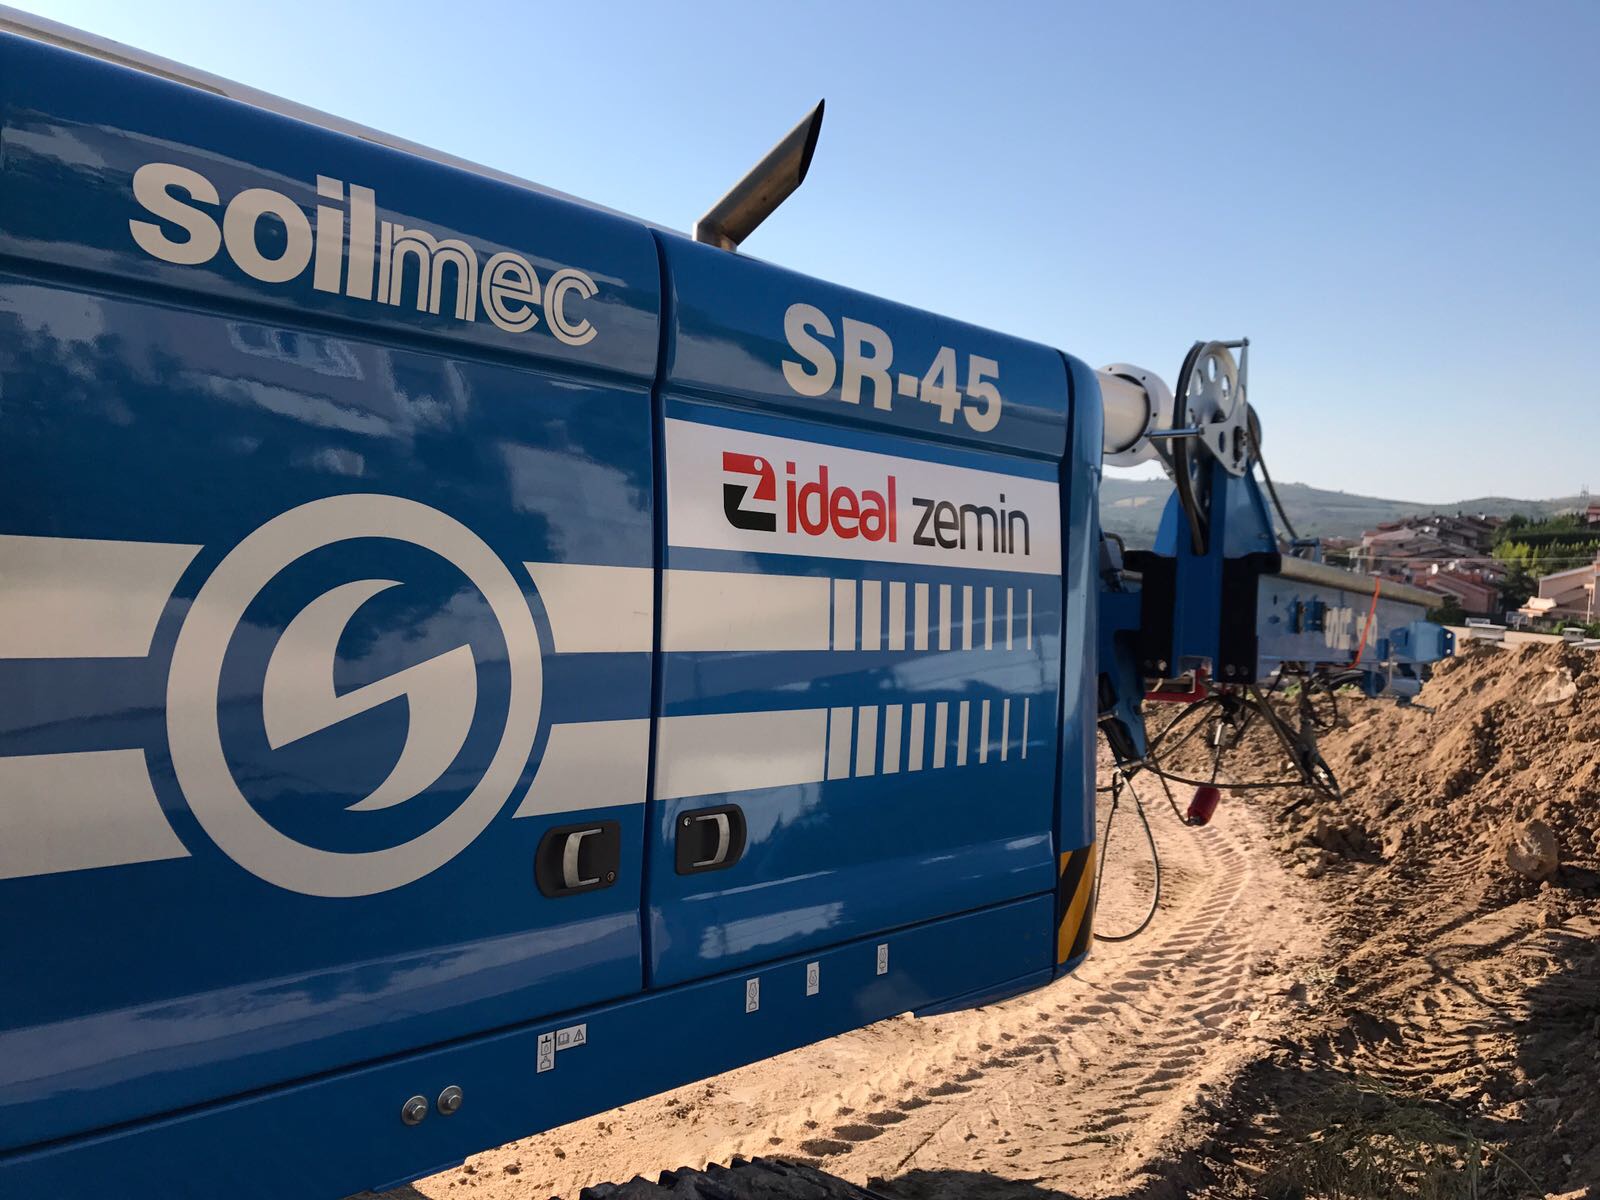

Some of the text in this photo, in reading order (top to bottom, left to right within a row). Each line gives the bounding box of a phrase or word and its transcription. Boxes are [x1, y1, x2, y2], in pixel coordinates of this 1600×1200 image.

[128, 162, 601, 347] soilmec
[781, 303, 1002, 433] SR-45
[786, 461, 1030, 556] ideal zemin
